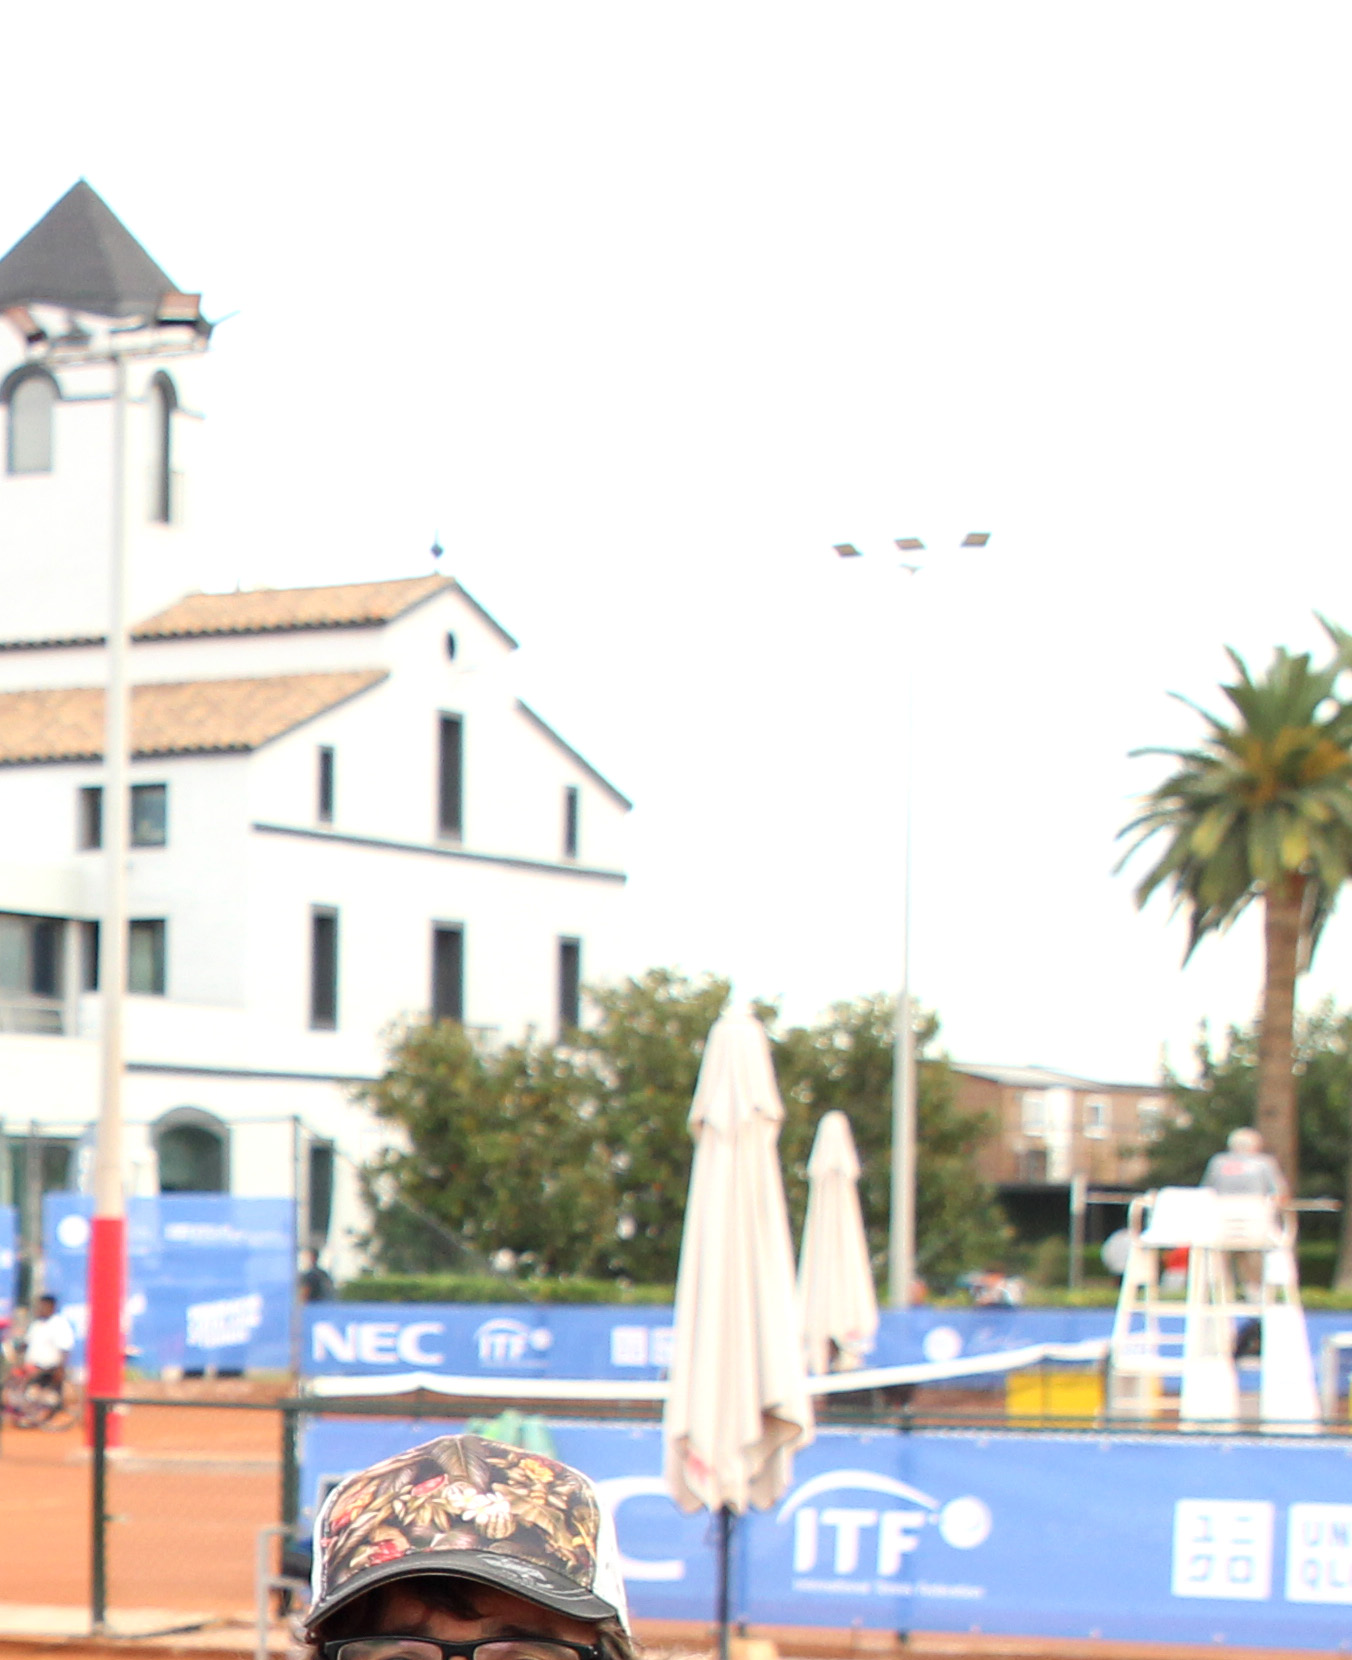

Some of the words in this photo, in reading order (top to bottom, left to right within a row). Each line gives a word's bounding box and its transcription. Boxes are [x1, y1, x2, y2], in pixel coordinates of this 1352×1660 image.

[311, 1321, 445, 1365] NEC
[477, 1333, 528, 1364] ITF
[793, 1508, 925, 1576] ITF
